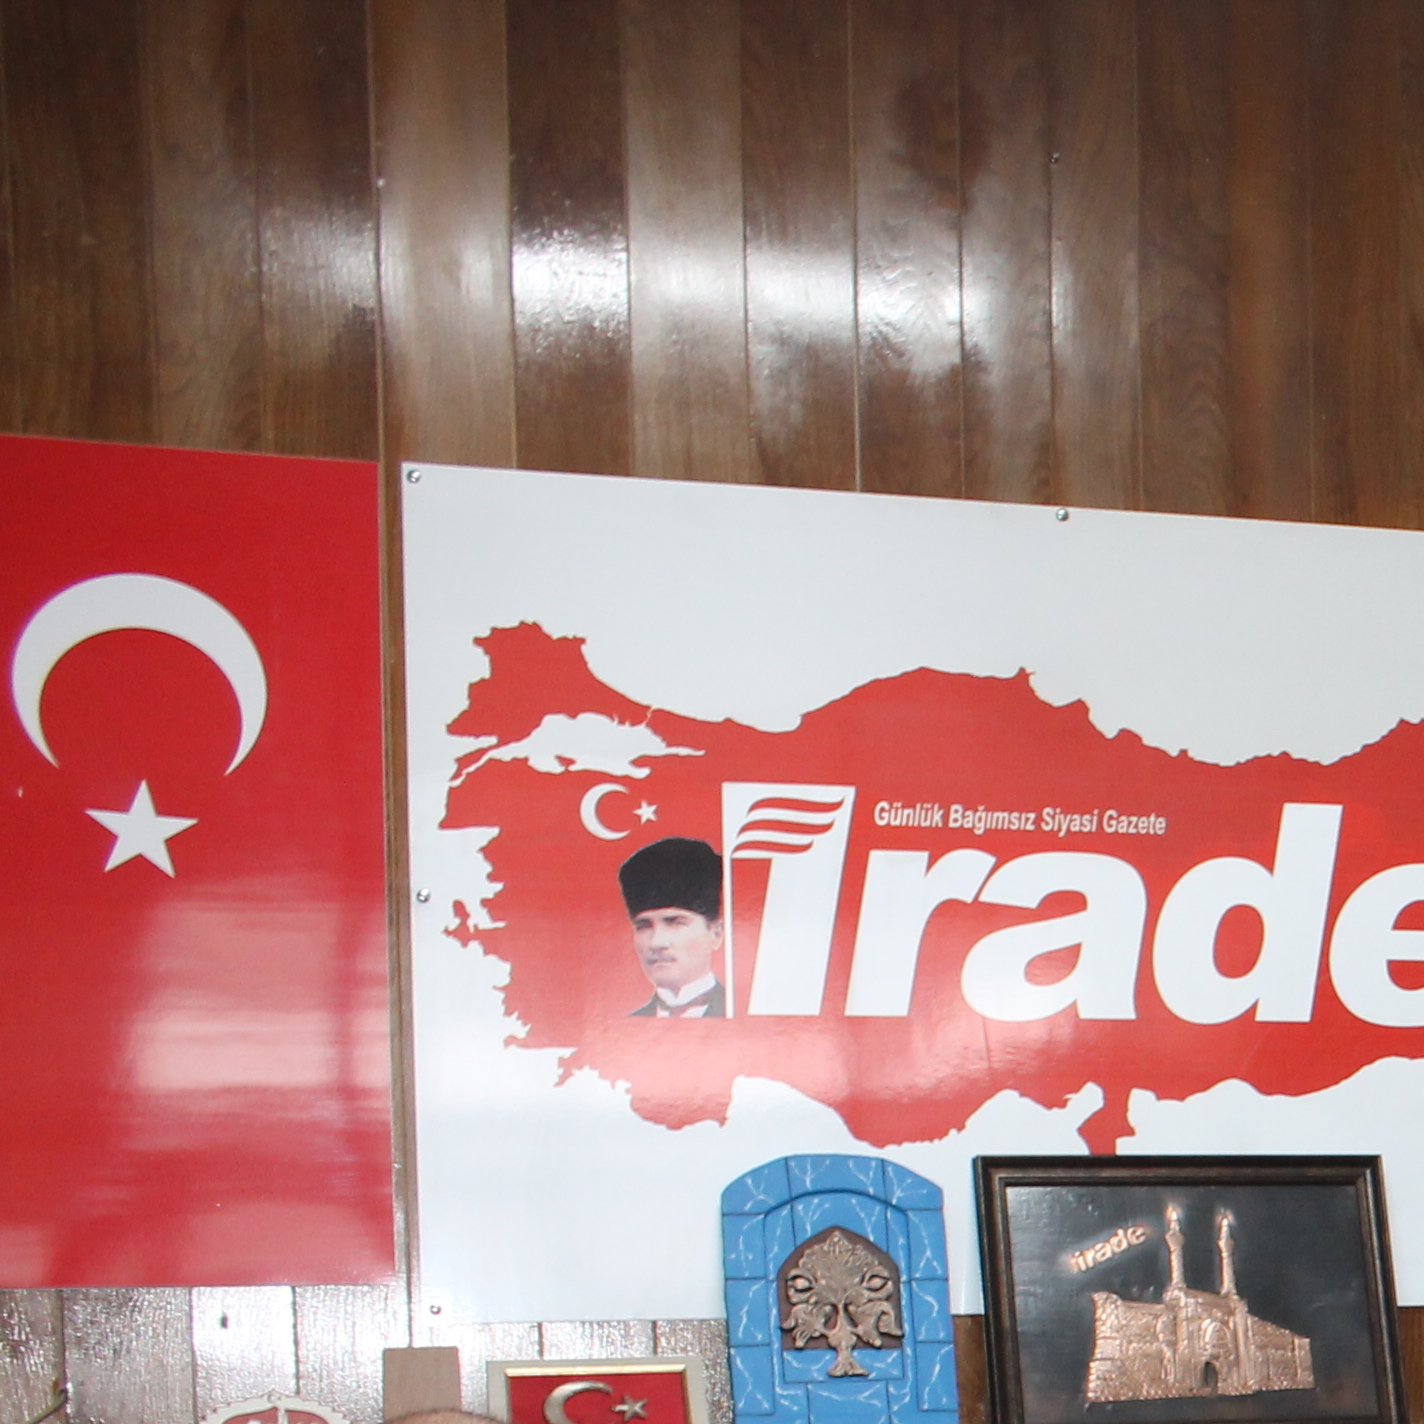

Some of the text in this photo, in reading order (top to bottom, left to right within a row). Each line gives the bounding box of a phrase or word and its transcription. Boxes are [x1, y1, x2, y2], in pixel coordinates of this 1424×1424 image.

[874, 801, 1167, 837] Günlük Bağımsız Siyasi Gazete
